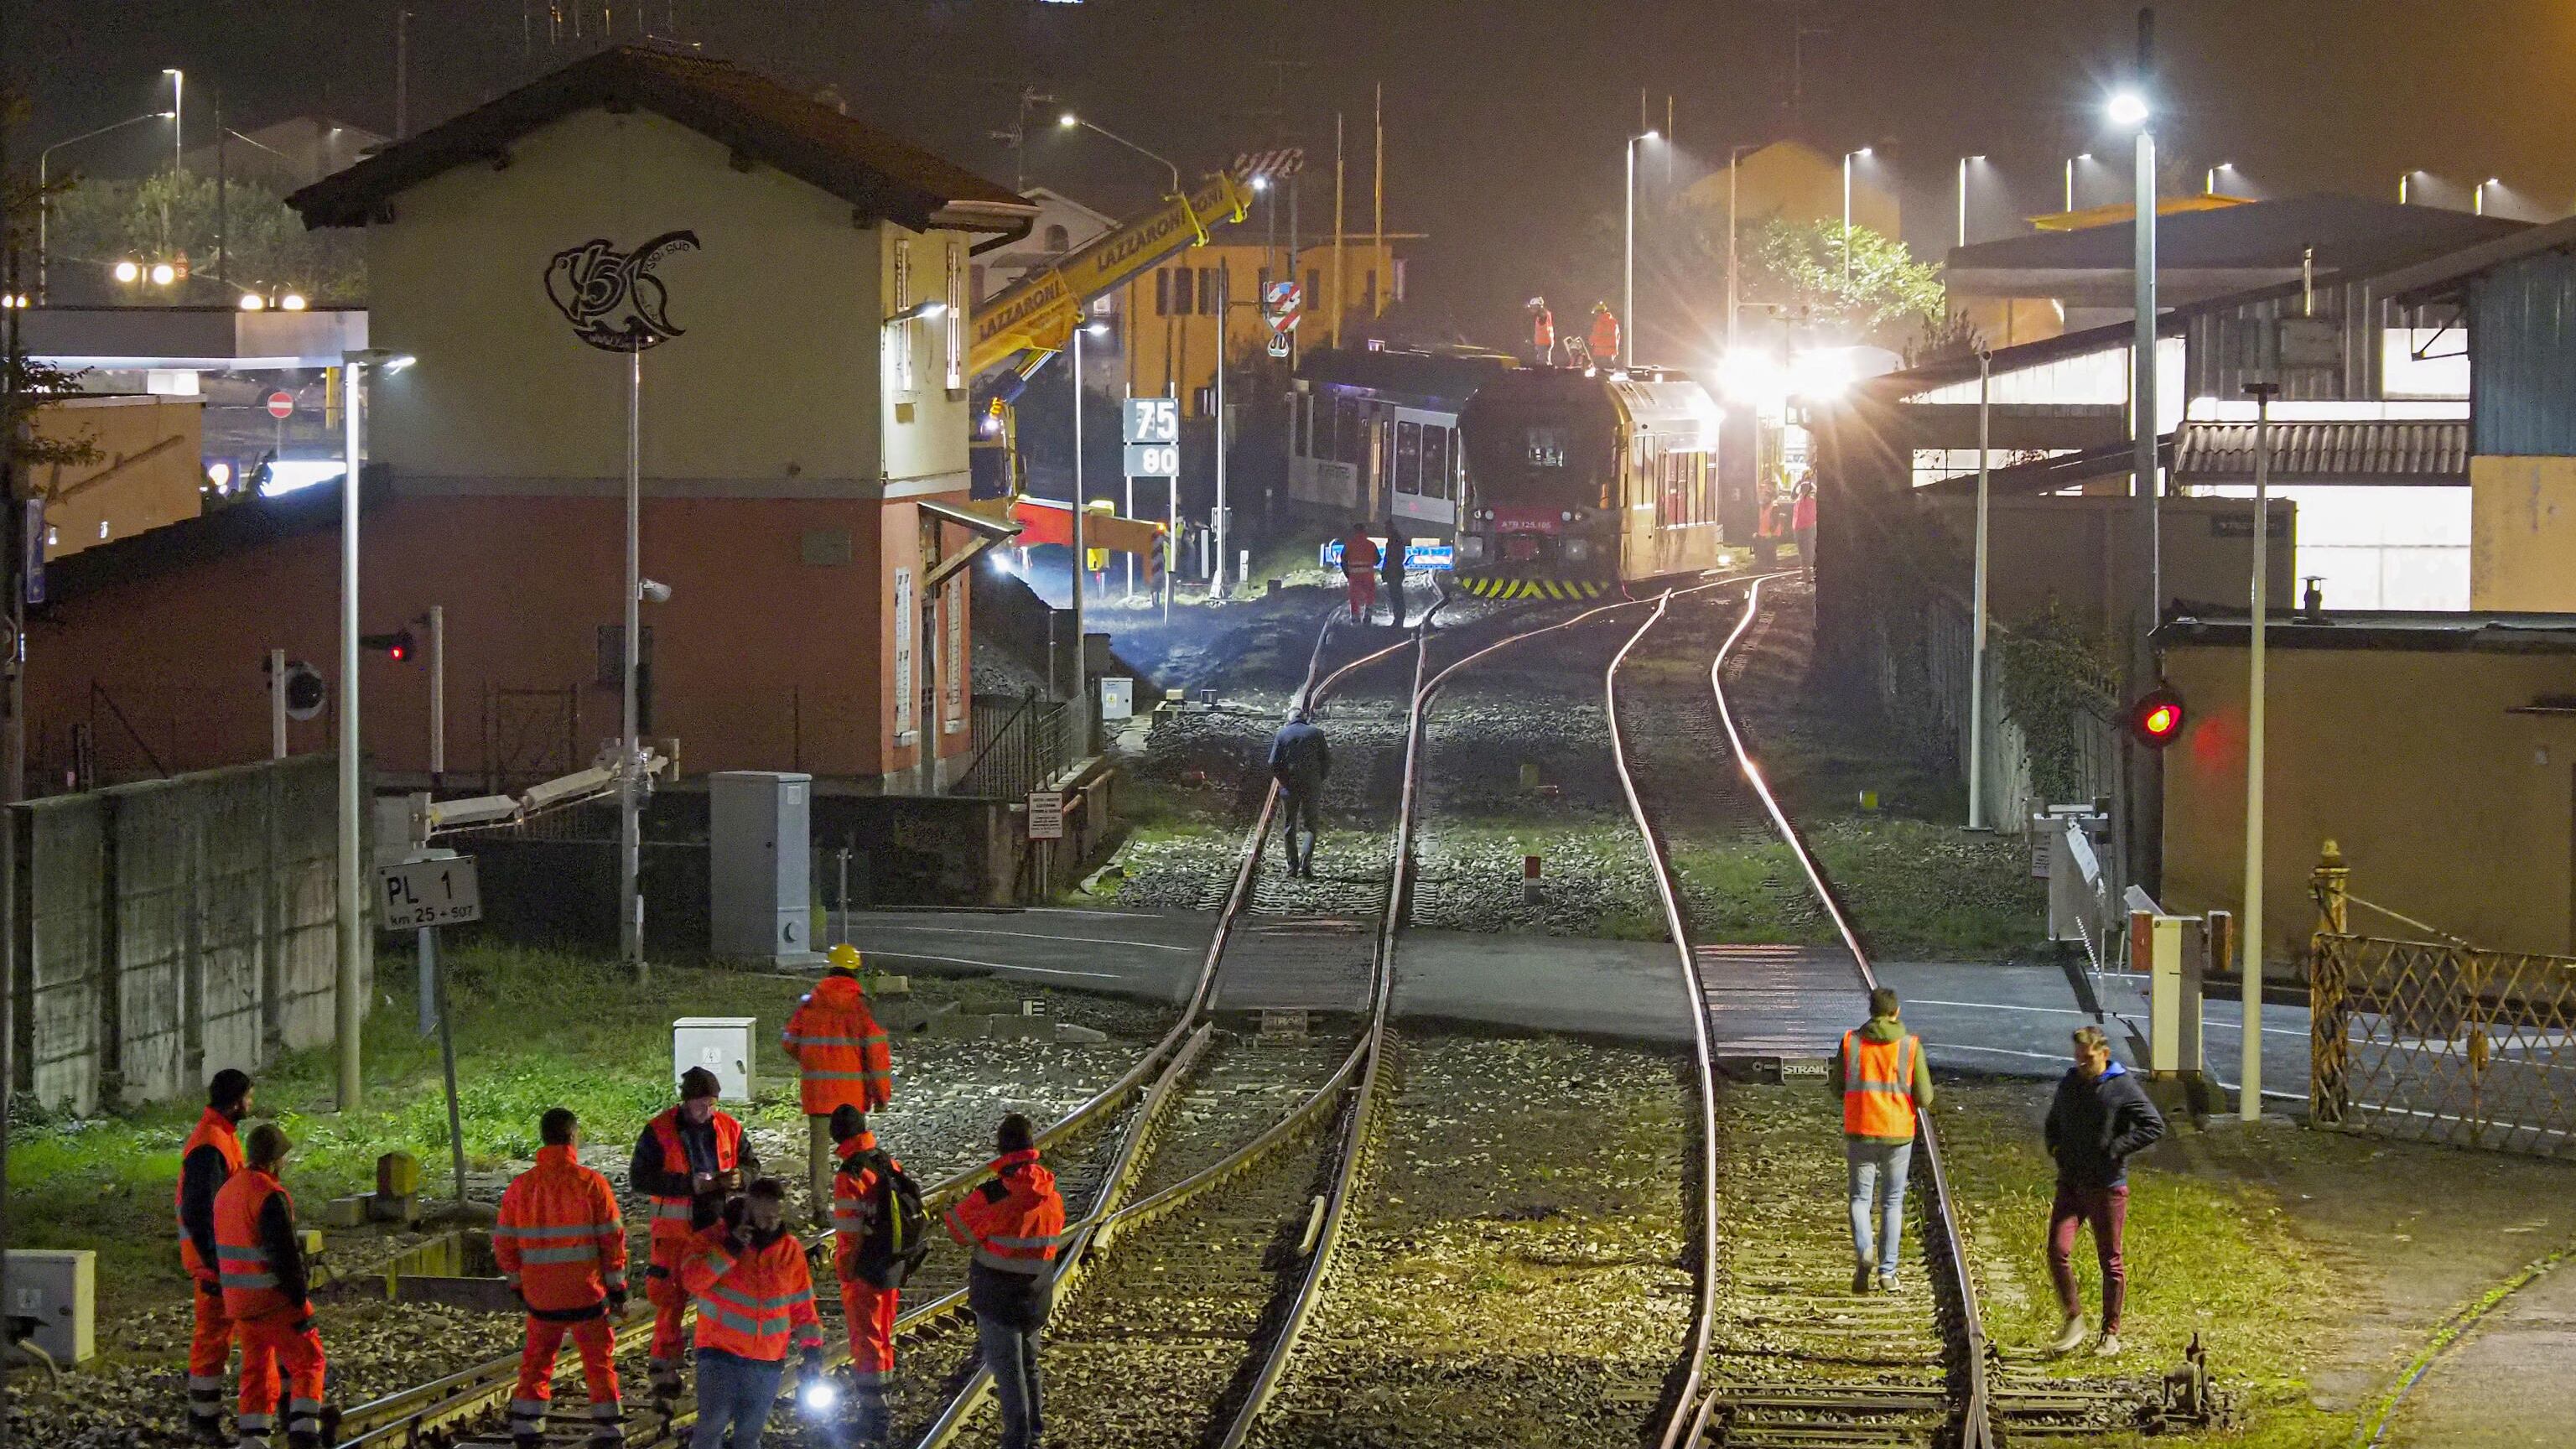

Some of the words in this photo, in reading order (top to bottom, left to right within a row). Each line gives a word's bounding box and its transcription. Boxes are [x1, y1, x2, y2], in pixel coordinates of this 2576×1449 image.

[1098, 205, 1186, 272] LAZZARONI
[979, 279, 1060, 340] LAZZARONI
[1136, 402, 1176, 439] 75
[1143, 448, 1176, 474] 80
[387, 875, 419, 906] PL
[441, 870, 451, 899] 1
[391, 915, 410, 926] km
[415, 907, 435, 922] 25
[1784, 1065, 1826, 1074] STRAIL
